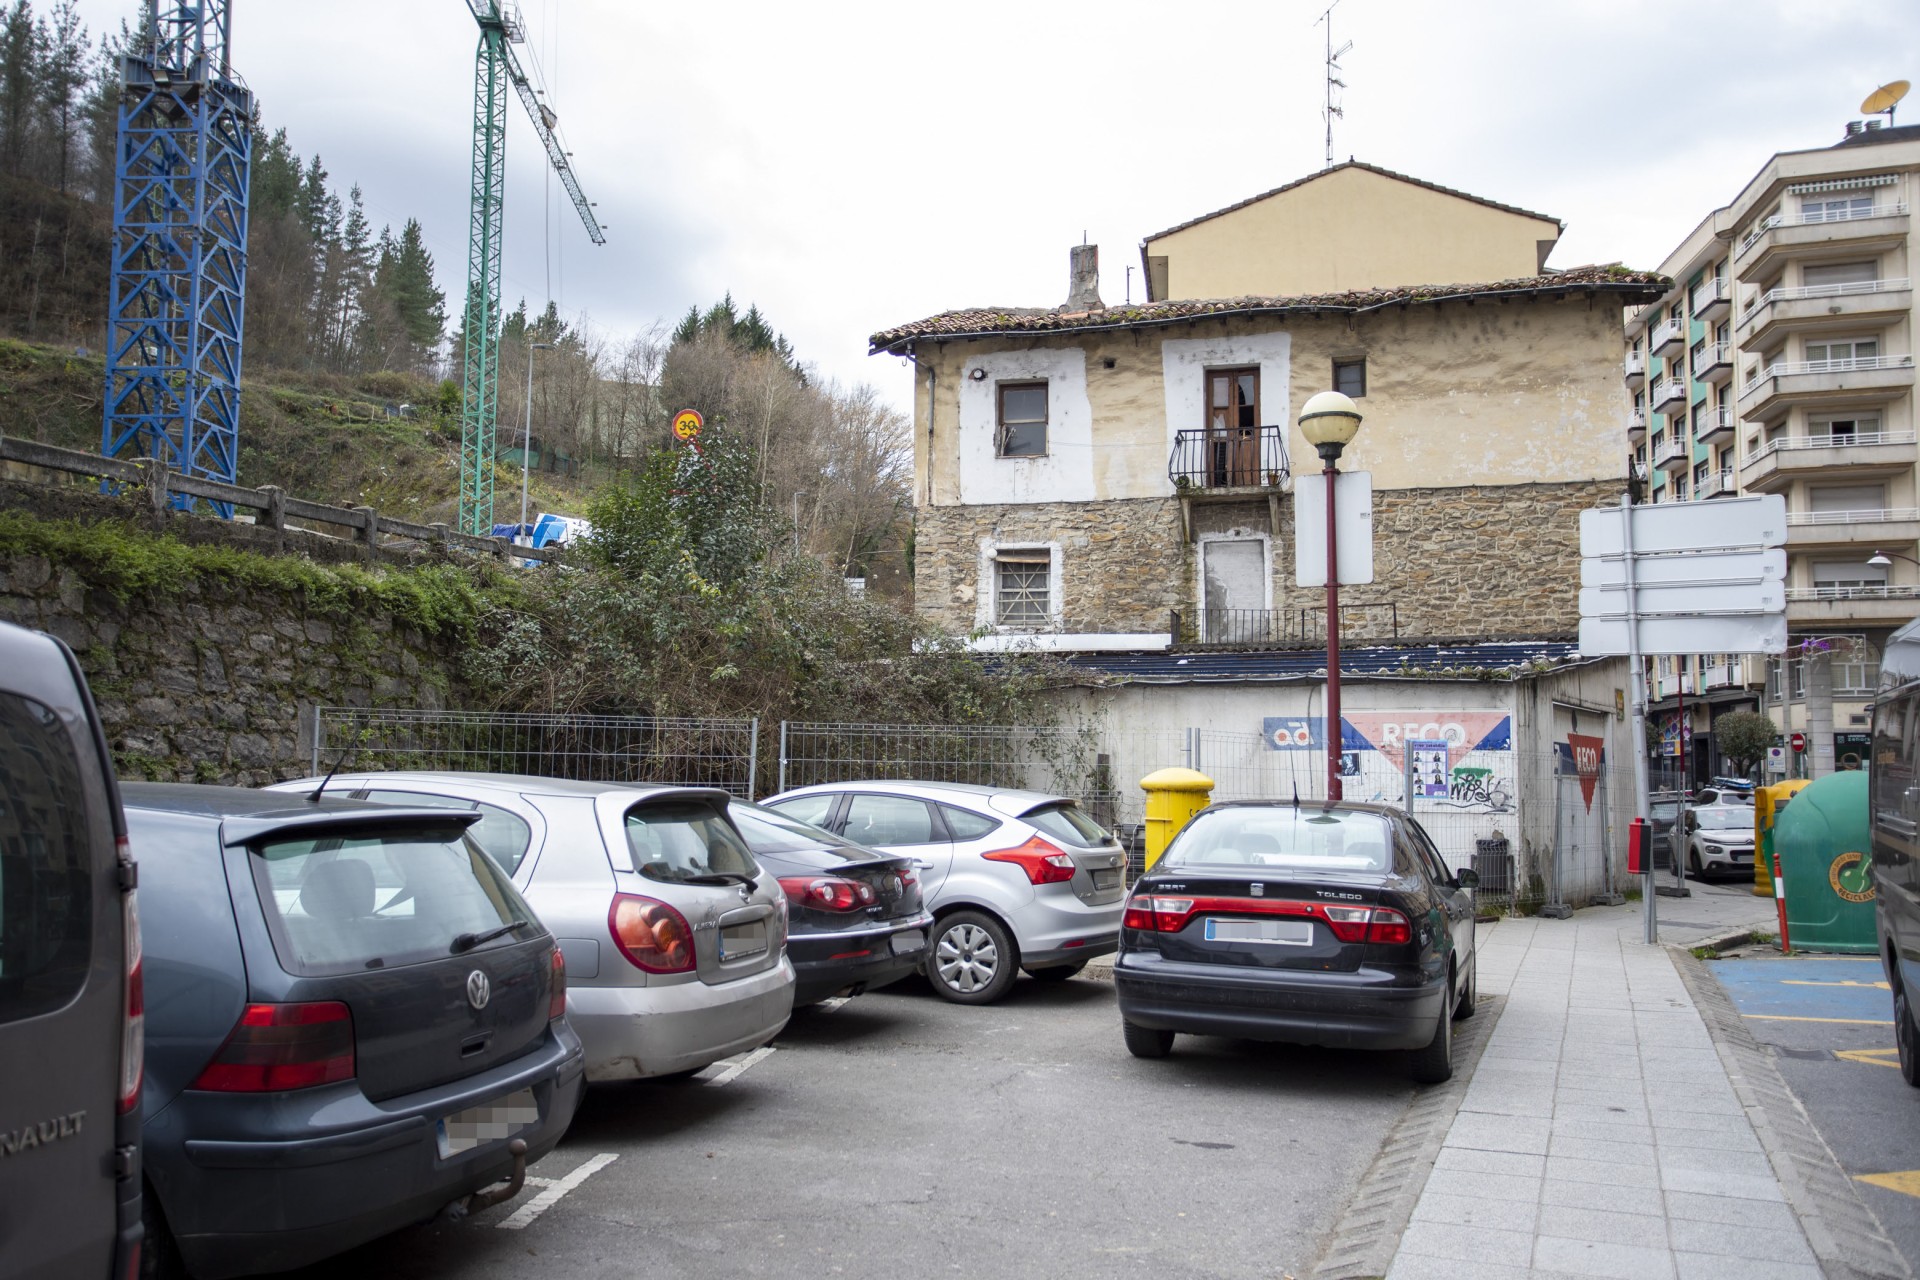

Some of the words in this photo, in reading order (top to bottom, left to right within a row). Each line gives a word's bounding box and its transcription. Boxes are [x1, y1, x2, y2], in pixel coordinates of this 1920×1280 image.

[679, 420, 696, 431] 30
[1382, 722, 1466, 749] RECO
[1576, 746, 1597, 773] RECO
[1316, 890, 1362, 900] TOLEDO
